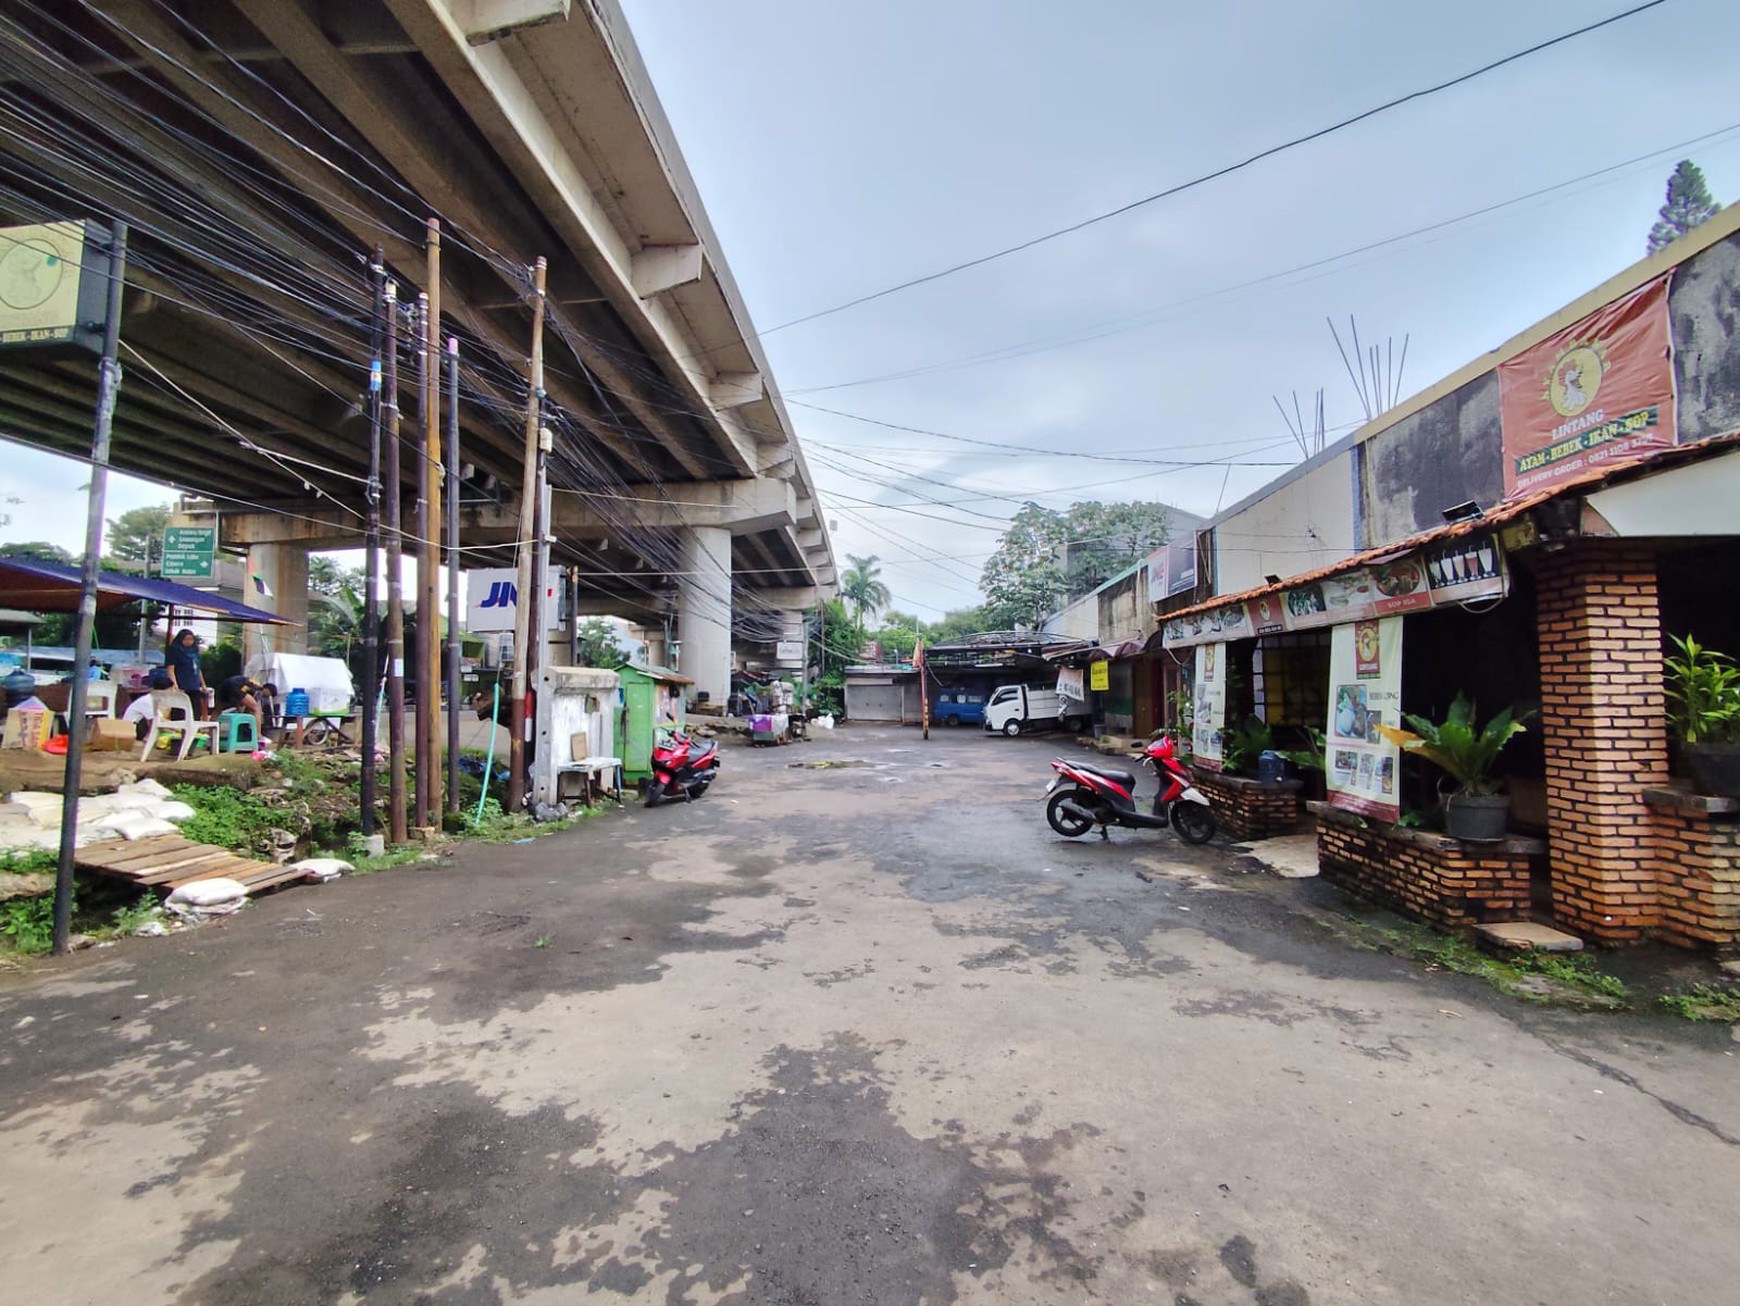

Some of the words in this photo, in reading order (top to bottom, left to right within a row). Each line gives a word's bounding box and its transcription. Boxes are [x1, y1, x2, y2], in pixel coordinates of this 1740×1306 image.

[1552, 408, 1605, 441] LINTANG
[1519, 451, 1546, 473] AYAM
[1550, 436, 1583, 461] BEBEK
[1588, 423, 1618, 446] IKAN
[1625, 411, 1649, 431] SOP
[1517, 470, 1553, 489] DELIVERY
